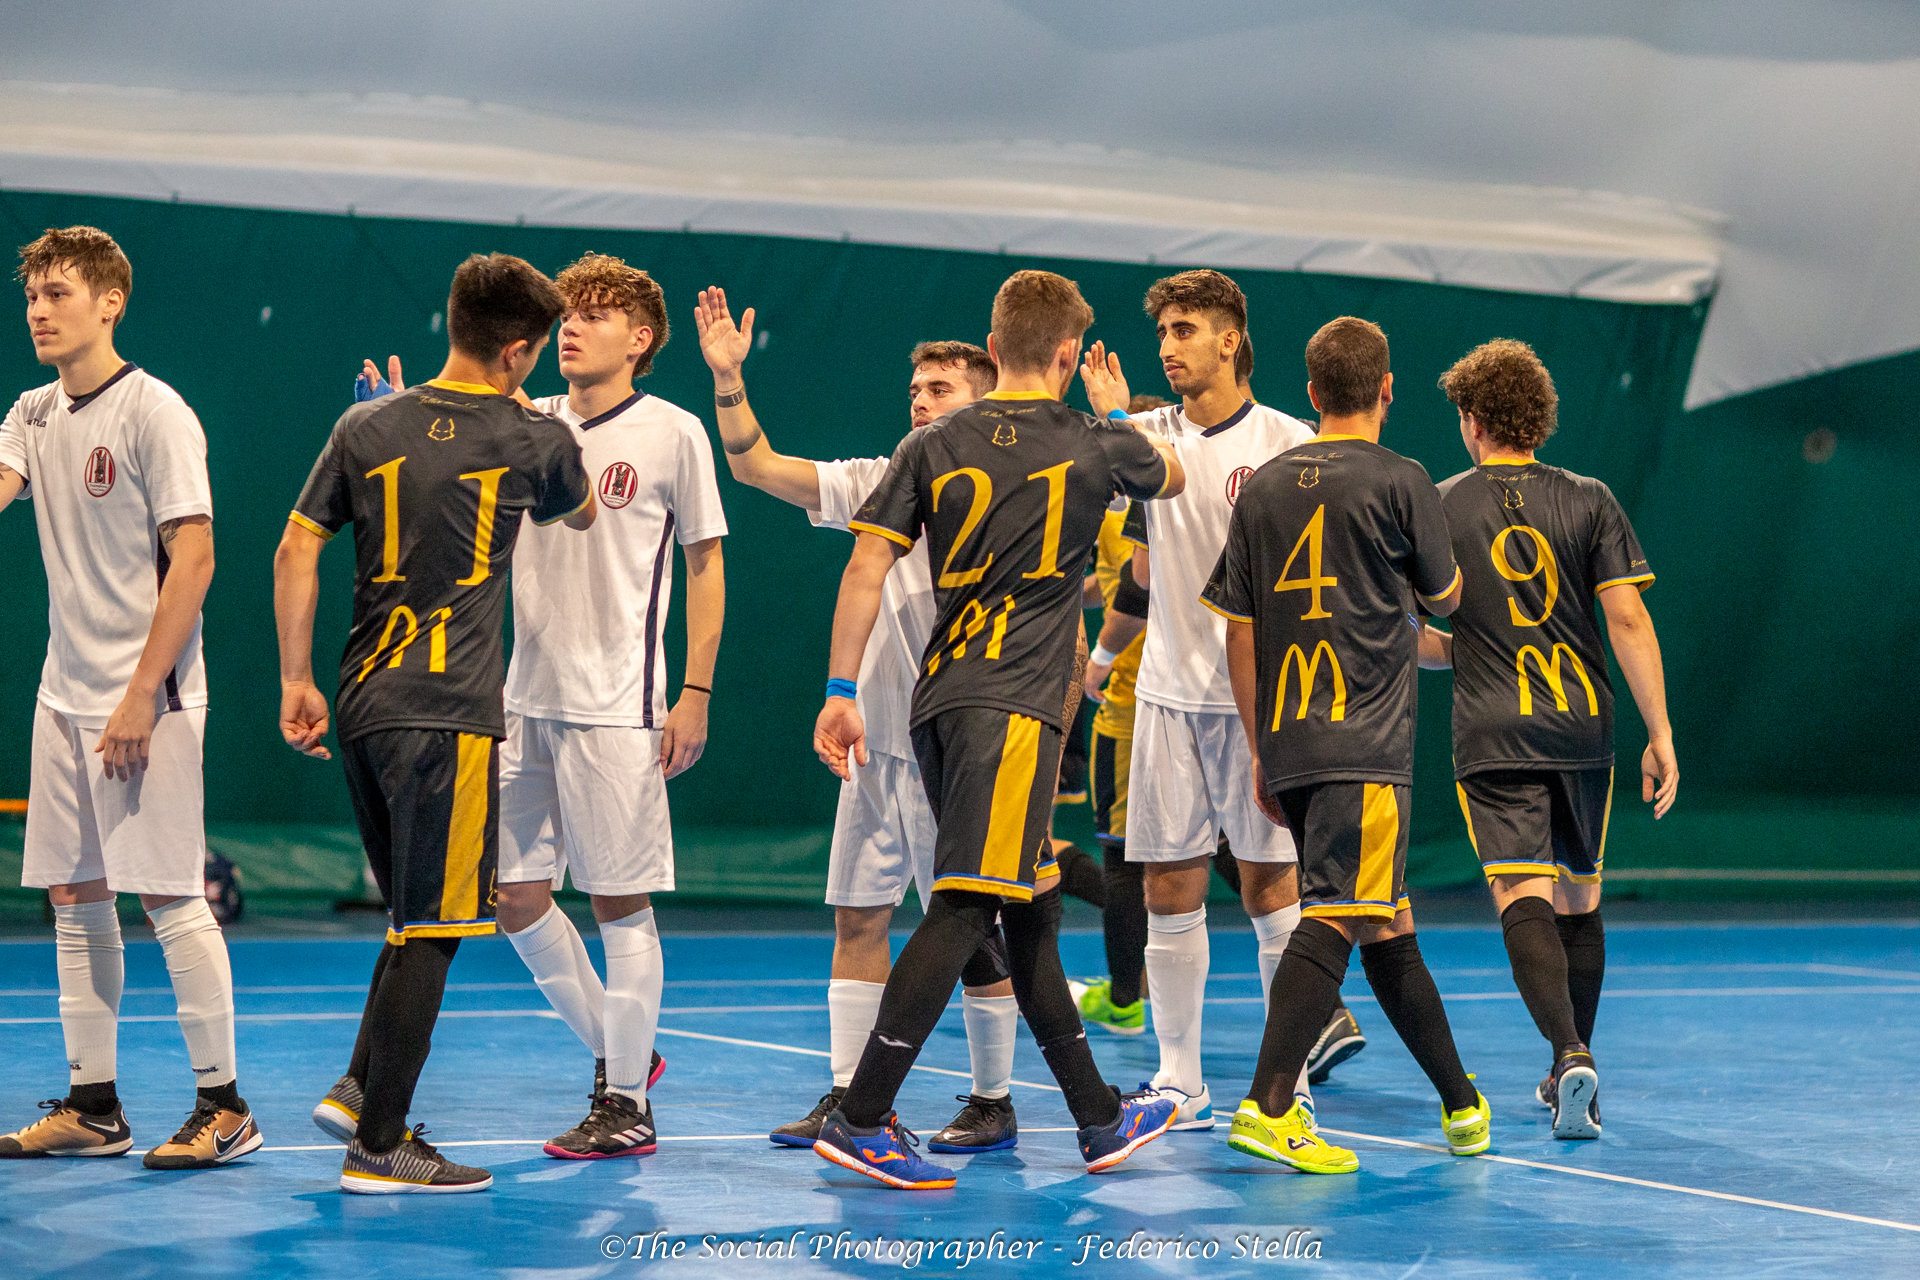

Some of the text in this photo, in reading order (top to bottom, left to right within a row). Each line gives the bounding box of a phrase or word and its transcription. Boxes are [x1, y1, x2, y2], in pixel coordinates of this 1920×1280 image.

[364, 456, 510, 586] 11
[930, 459, 1075, 588] 21
[1273, 503, 1338, 621] 4
[1490, 524, 1560, 627] 9
